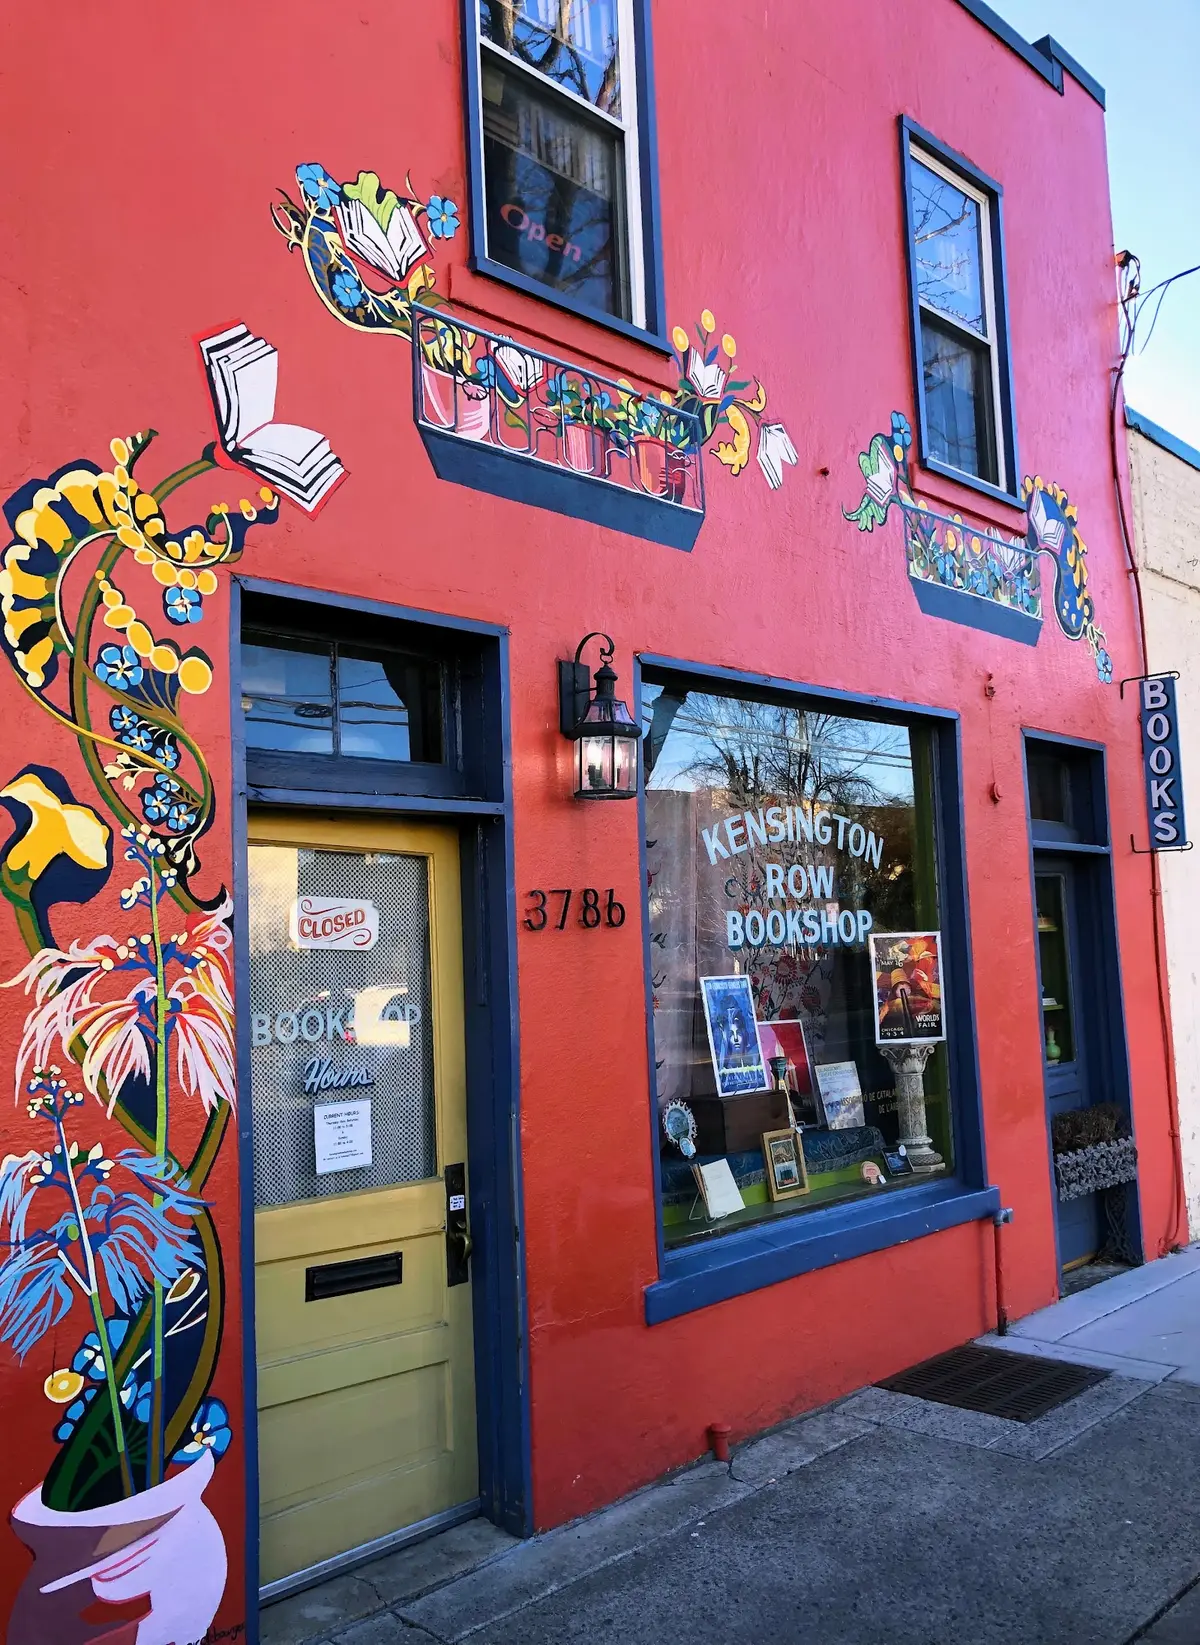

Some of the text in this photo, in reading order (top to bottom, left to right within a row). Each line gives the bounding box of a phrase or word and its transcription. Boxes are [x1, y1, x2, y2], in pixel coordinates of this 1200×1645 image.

[500, 204, 582, 262] Open
[1143, 679, 1178, 842] BOOKS
[701, 806, 884, 869] KENSINGTON
[766, 864, 834, 899] ROW
[299, 908, 366, 939] CLOSED
[524, 888, 626, 931] 3786
[727, 910, 873, 950] BOOKSHOP
[252, 1003, 422, 1047] BOOKOP
[303, 1055, 374, 1095] Hours
